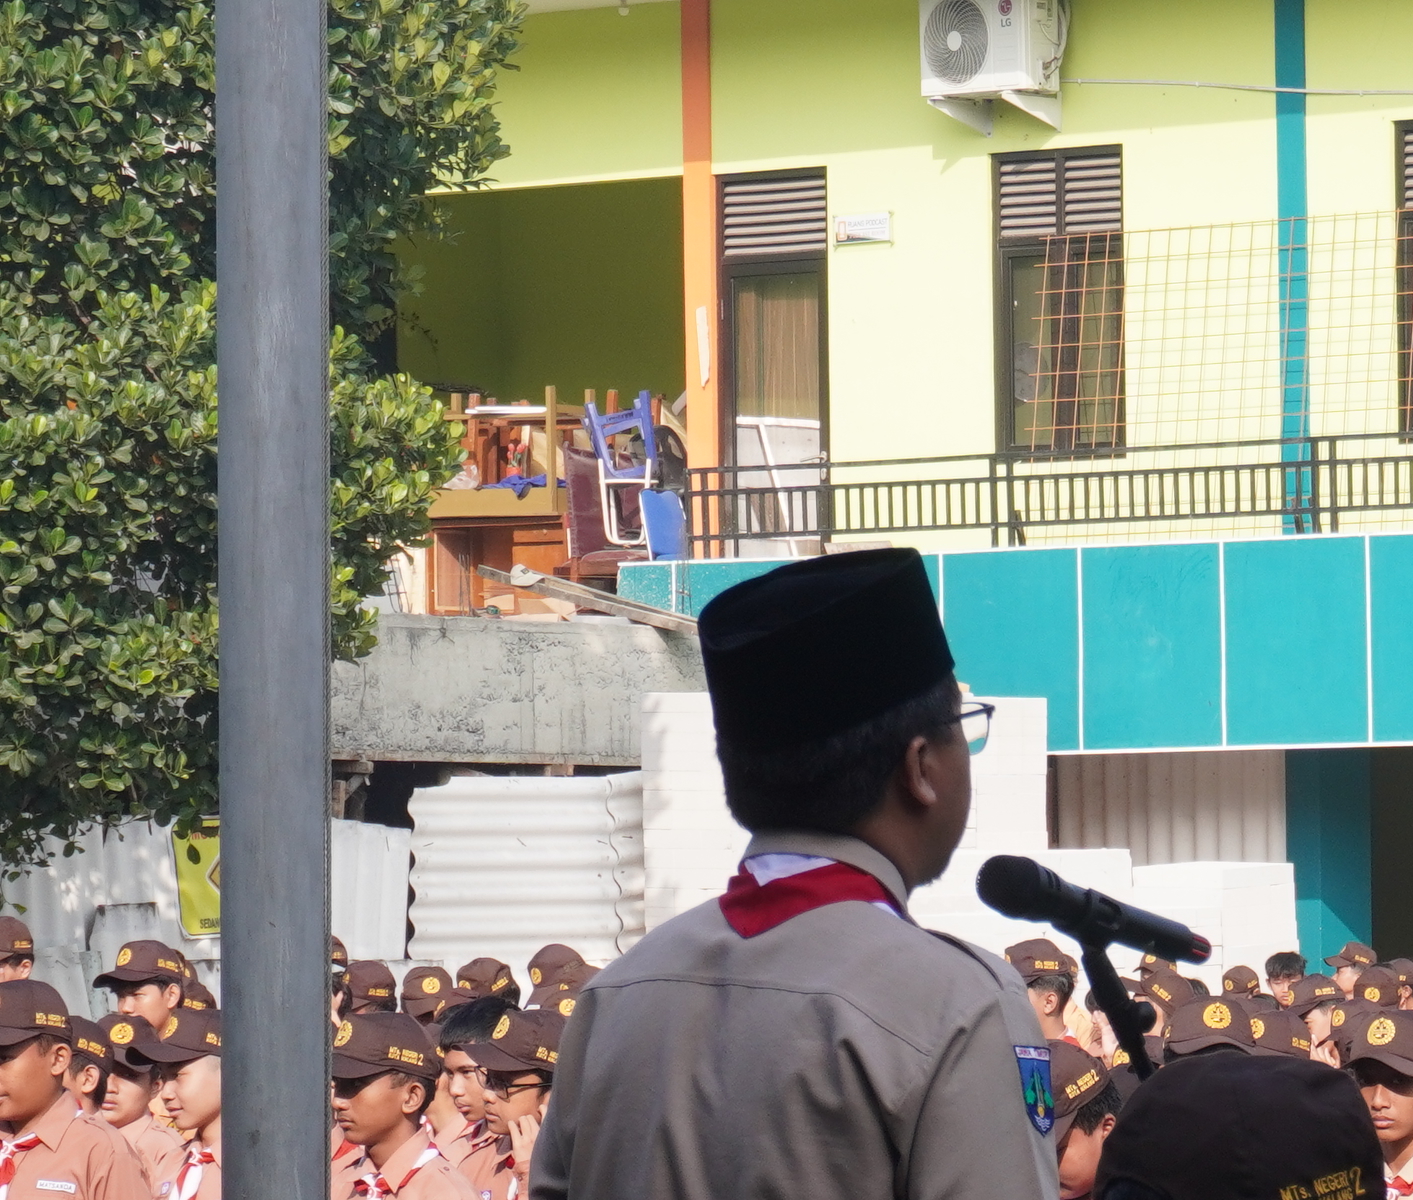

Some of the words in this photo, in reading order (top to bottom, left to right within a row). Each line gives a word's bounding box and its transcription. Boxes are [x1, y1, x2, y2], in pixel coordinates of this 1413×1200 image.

[1001, 18, 1011, 27] LG
[866, 218, 887, 226] PODCAST
[39, 1181, 73, 1191] MATSANDA
[1313, 1170, 1349, 1197] NEGERI
[1349, 1166, 1366, 1196] 2
